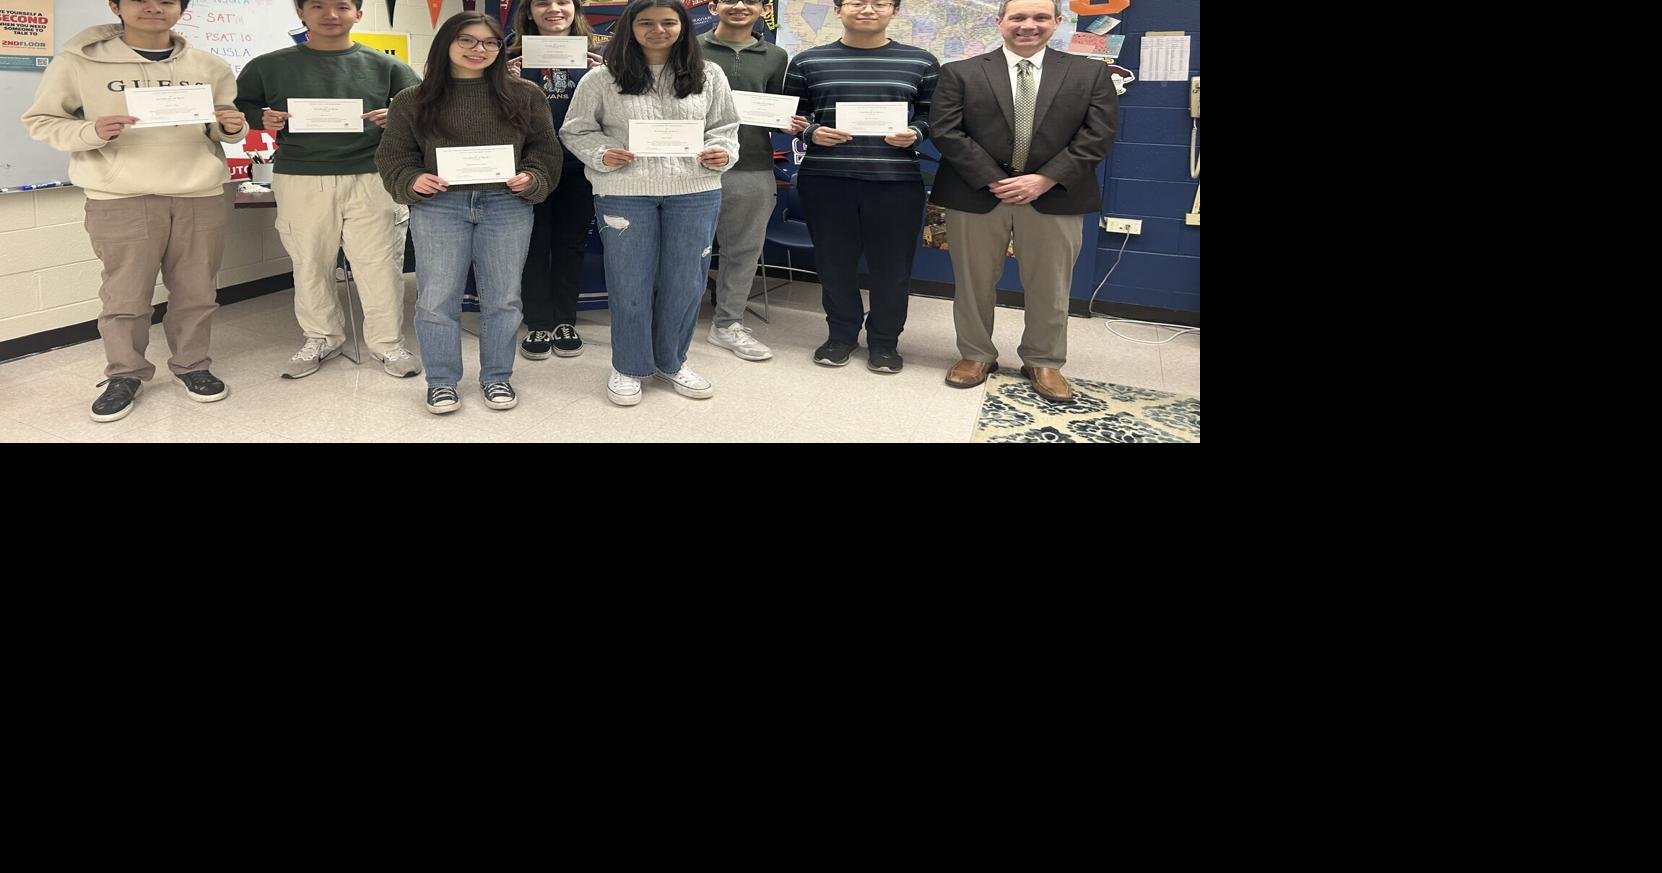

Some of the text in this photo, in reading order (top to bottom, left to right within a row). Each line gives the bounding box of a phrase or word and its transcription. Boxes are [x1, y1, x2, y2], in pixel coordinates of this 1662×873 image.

[206, 12, 236, 23] SAT
[205, 32, 237, 42] PSAT
[107, 80, 204, 93] GUE
